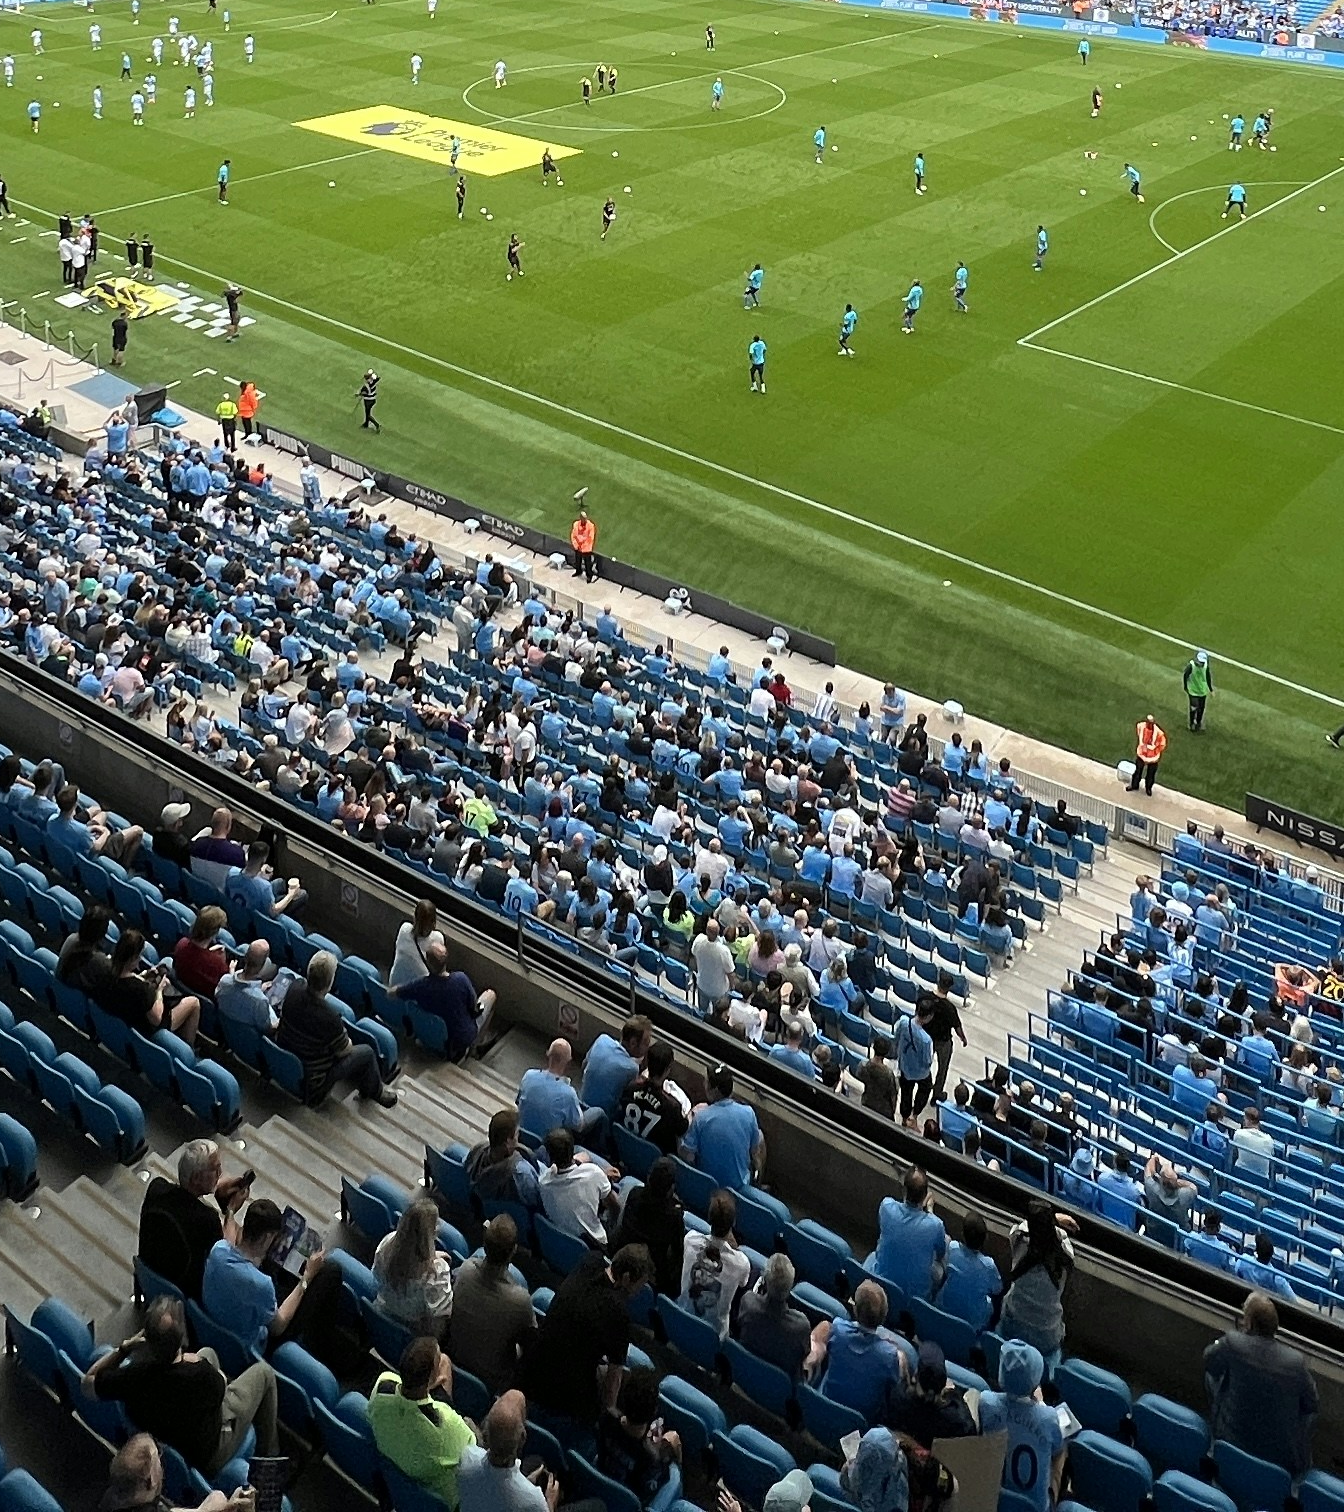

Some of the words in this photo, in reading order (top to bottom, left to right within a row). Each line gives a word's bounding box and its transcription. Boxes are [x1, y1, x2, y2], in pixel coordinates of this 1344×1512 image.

[1018, 2, 1063, 15] HOSPITALITY
[405, 483, 447, 506] ETIHAD
[481, 514, 525, 537] ETIHAD
[624, 1103, 662, 1138] 87
